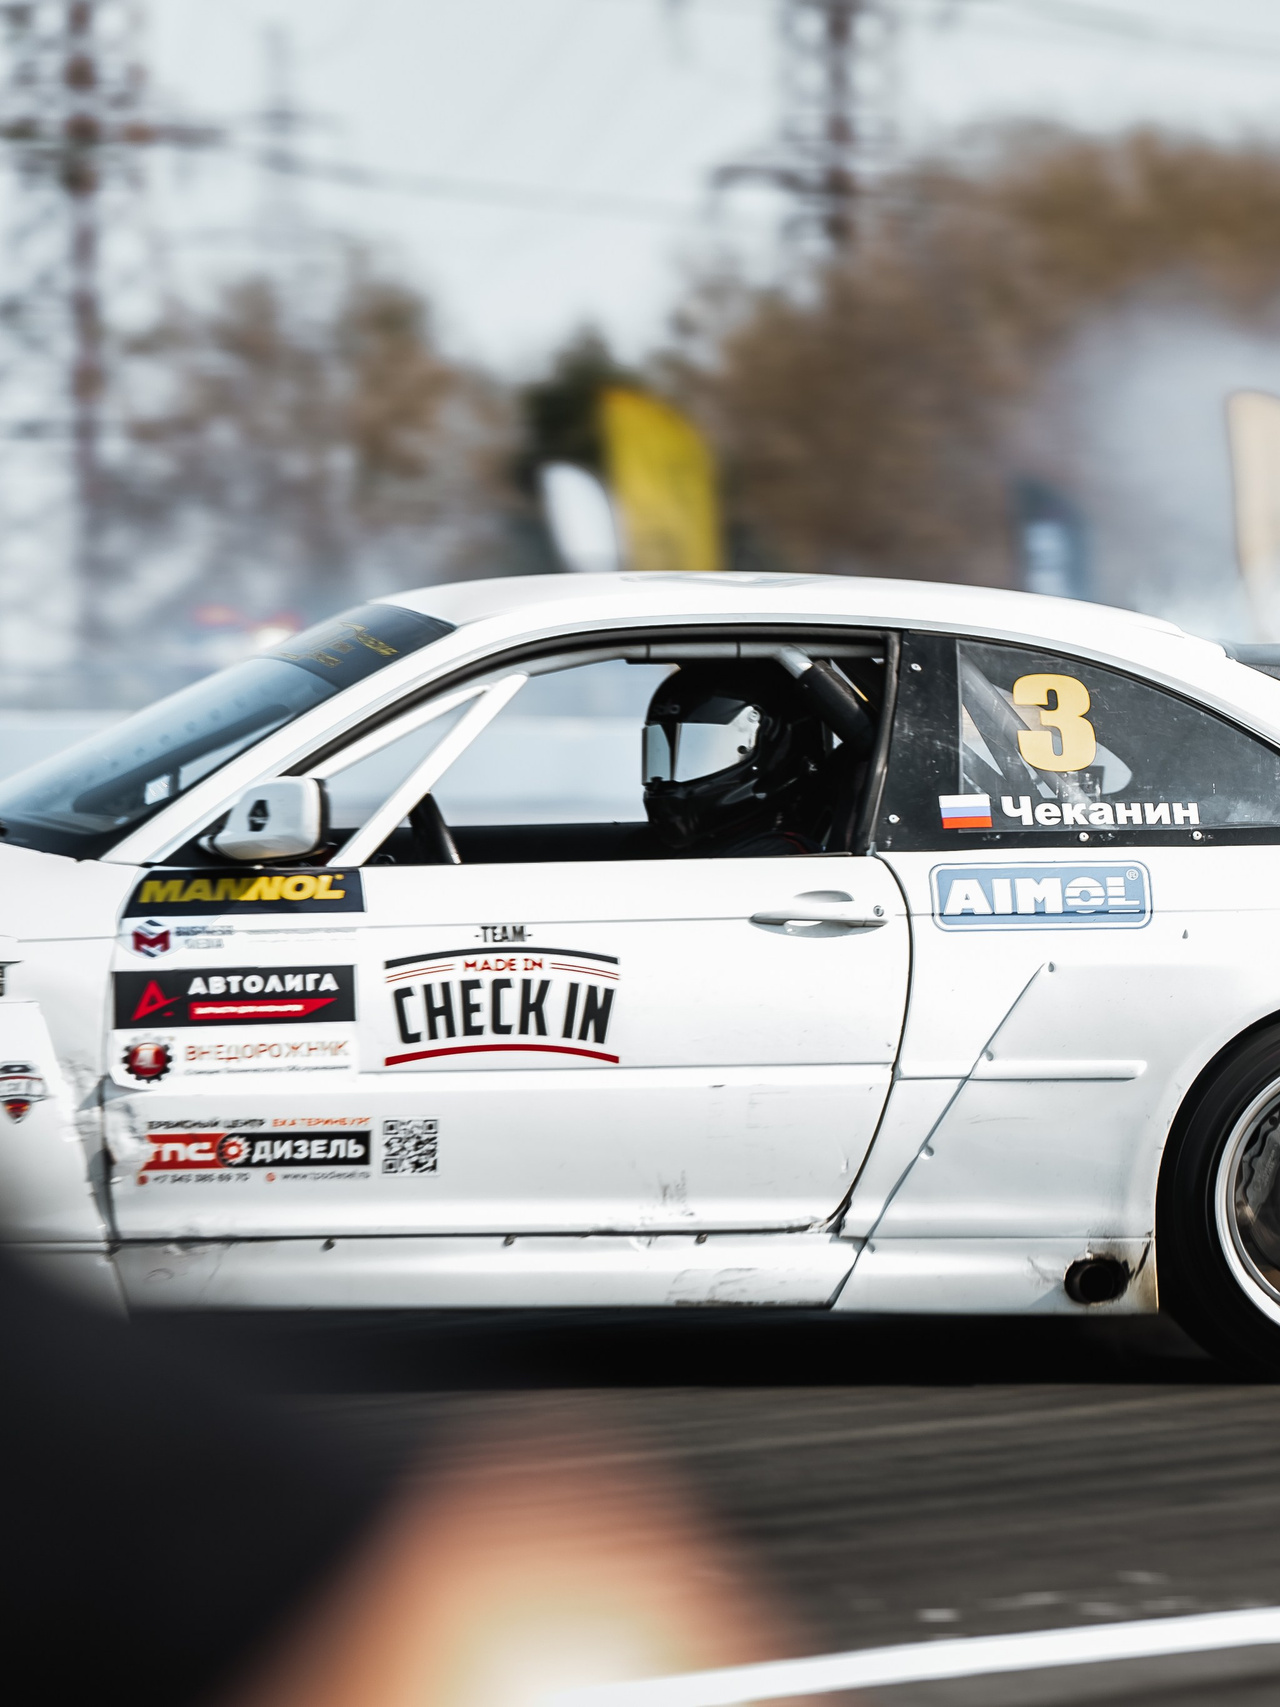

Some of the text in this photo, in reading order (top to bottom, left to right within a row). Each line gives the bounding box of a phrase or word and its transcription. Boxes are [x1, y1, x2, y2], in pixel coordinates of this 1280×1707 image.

[1012, 673, 1097, 772] 3
[1001, 795, 1201, 828] Чеканин
[139, 875, 346, 903] MANNOL
[944, 875, 1142, 916] AIMOL
[464, 958, 543, 972] MADE IN
[187, 973, 339, 996] АВТОЛИГА
[393, 978, 616, 1044] CHECK IN
[184, 1040, 349, 1062] ВНЕДОРОЖНИК
[251, 1138, 366, 1164] ДИЗЕЛЬ
